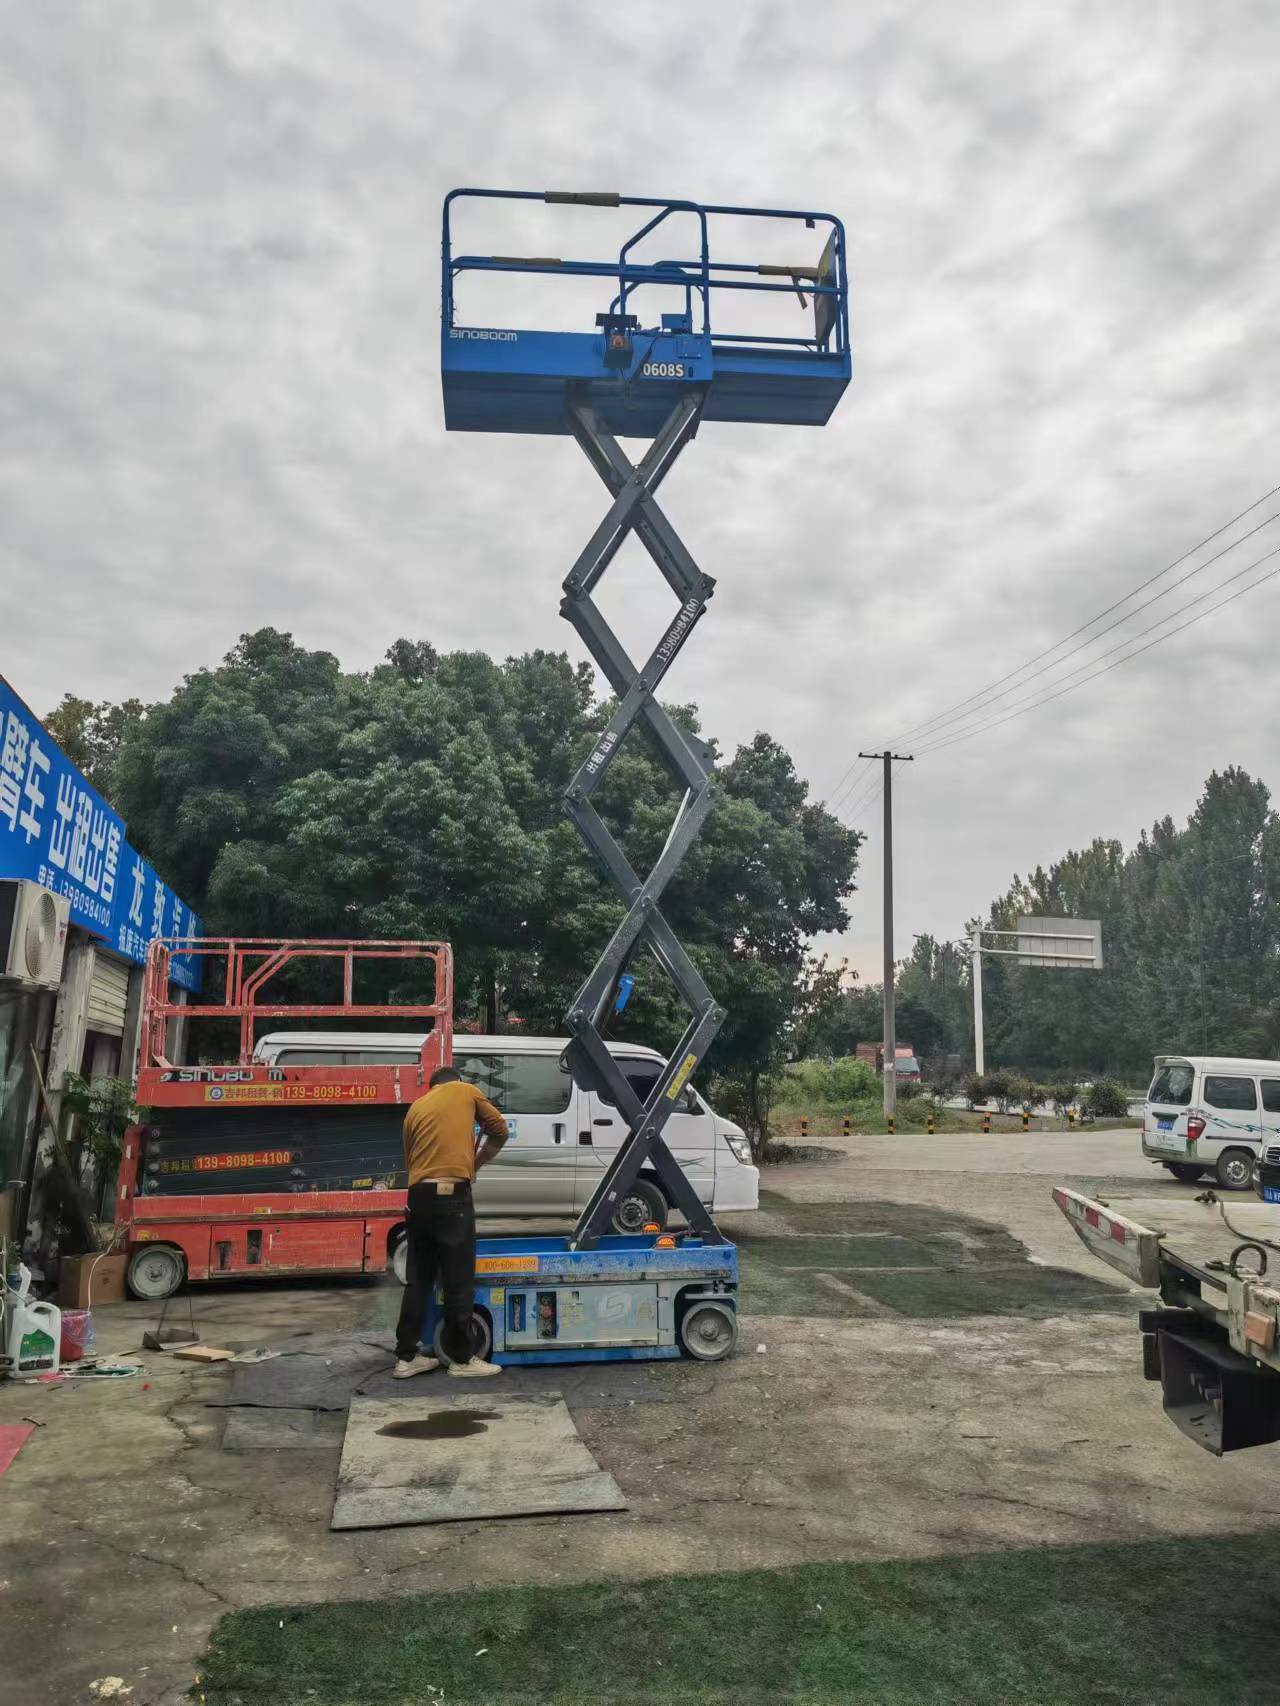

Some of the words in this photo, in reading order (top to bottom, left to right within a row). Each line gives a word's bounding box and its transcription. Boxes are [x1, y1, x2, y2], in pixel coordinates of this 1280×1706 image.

[642, 362, 684, 377] 0608S
[657, 598, 700, 662] 13980984100
[48, 773, 120, 902] 出租出售
[285, 1085, 377, 1098] 139-8098-4100
[198, 1150, 290, 1169] 139-8098-4100
